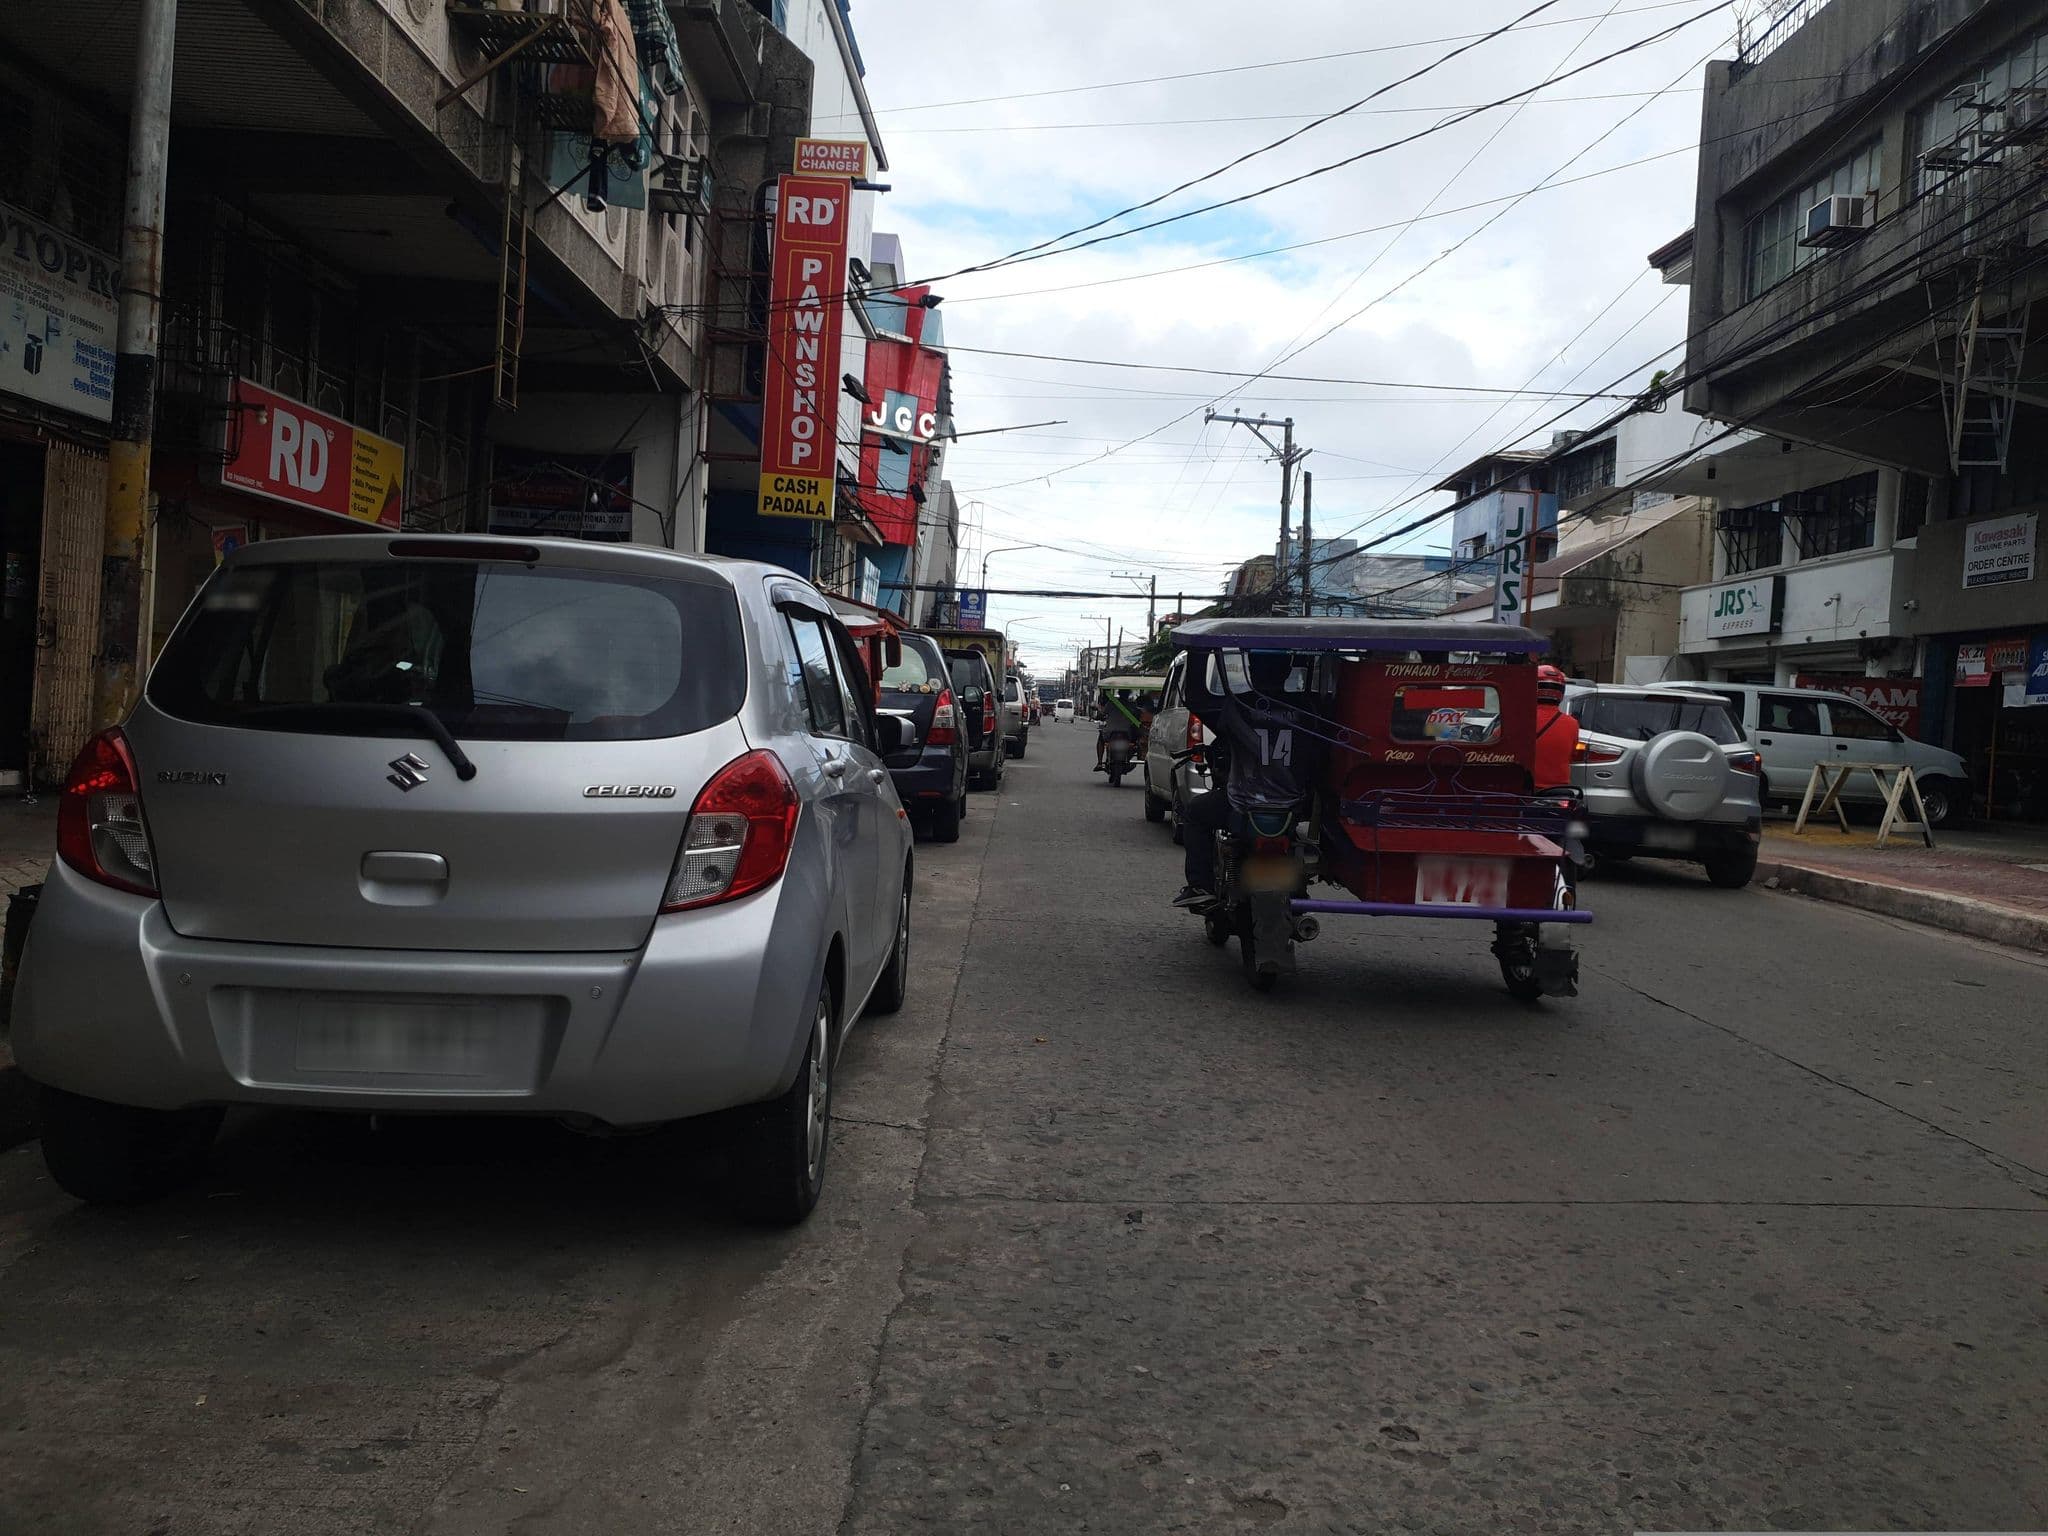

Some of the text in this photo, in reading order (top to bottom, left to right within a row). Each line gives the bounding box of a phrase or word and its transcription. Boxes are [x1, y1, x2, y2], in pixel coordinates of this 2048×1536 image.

[801, 144, 860, 159] MONEY
[801, 158, 860, 172] CHANGER
[787, 195, 835, 226] RD
[791, 258, 824, 466] PAWNSHOP
[871, 401, 937, 439] JGC
[269, 407, 329, 493] RD
[773, 477, 819, 496] CASH
[762, 495, 827, 517] PADALA
[1974, 523, 2028, 546] Kawasaki
[1501, 506, 1525, 612] JRS
[1967, 552, 2030, 572] ORDER CENTRE
[1714, 588, 1746, 617] JRS
[1722, 619, 1754, 631] EXPRESS
[1253, 728, 1293, 767] 14
[1385, 749, 1517, 765] Keep Distance
[158, 771, 227, 785] SUZUKI
[583, 785, 676, 798] CELERIO
